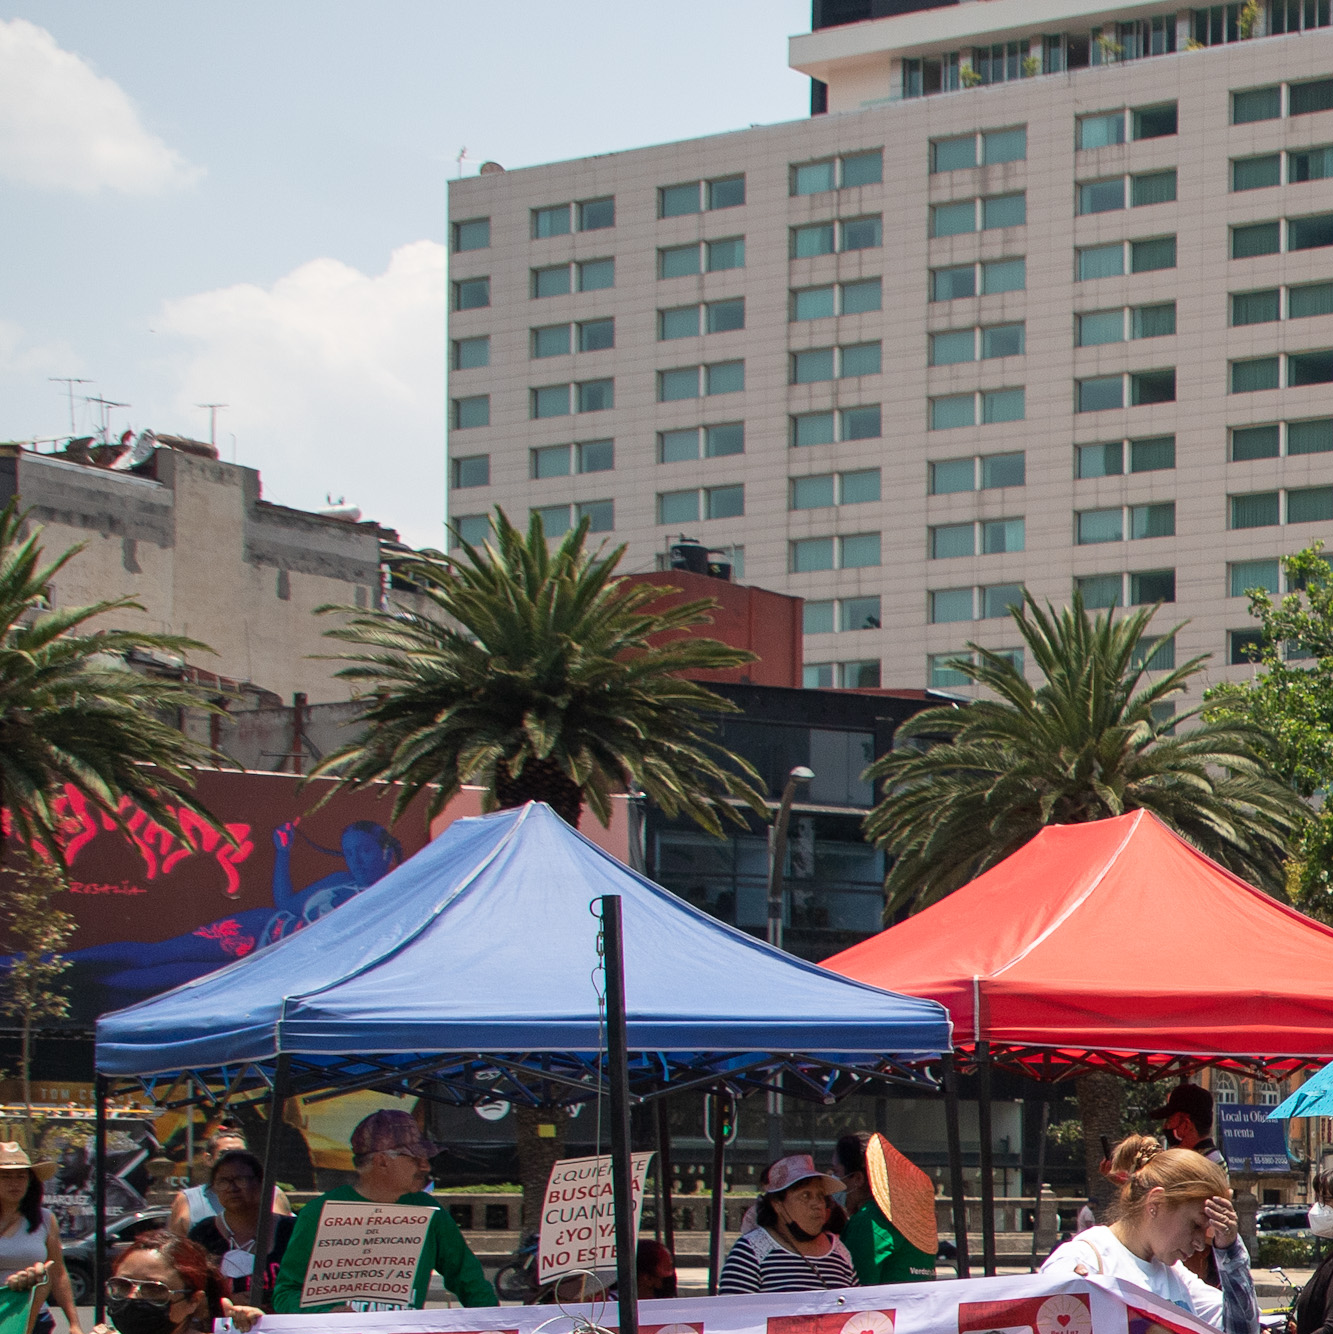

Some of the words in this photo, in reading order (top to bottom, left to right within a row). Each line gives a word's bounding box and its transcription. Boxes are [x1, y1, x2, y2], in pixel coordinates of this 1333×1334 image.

[1221, 1110, 1241, 1122] Local
[1224, 1130, 1232, 1138] en
[1234, 1129, 1254, 1138] renta
[549, 1175, 640, 1204] BUSCAÁ
[545, 1200, 637, 1224] CUAND
[324, 1217, 363, 1227] GRAN
[366, 1215, 428, 1225] FRACASO
[318, 1238, 360, 1247] ESTADO
[362, 1236, 422, 1246] MEXICANO
[555, 1226, 593, 1245] ¿YO
[313, 1260, 333, 1269] NO
[336, 1256, 416, 1267] ENCONTRAR
[542, 1251, 570, 1270] NO
[310, 1274, 319, 1282] A
[322, 1269, 385, 1280] NUESTROS
[396, 1270, 412, 1279] AS
[306, 1282, 409, 1296] DESAPARECIDOS
